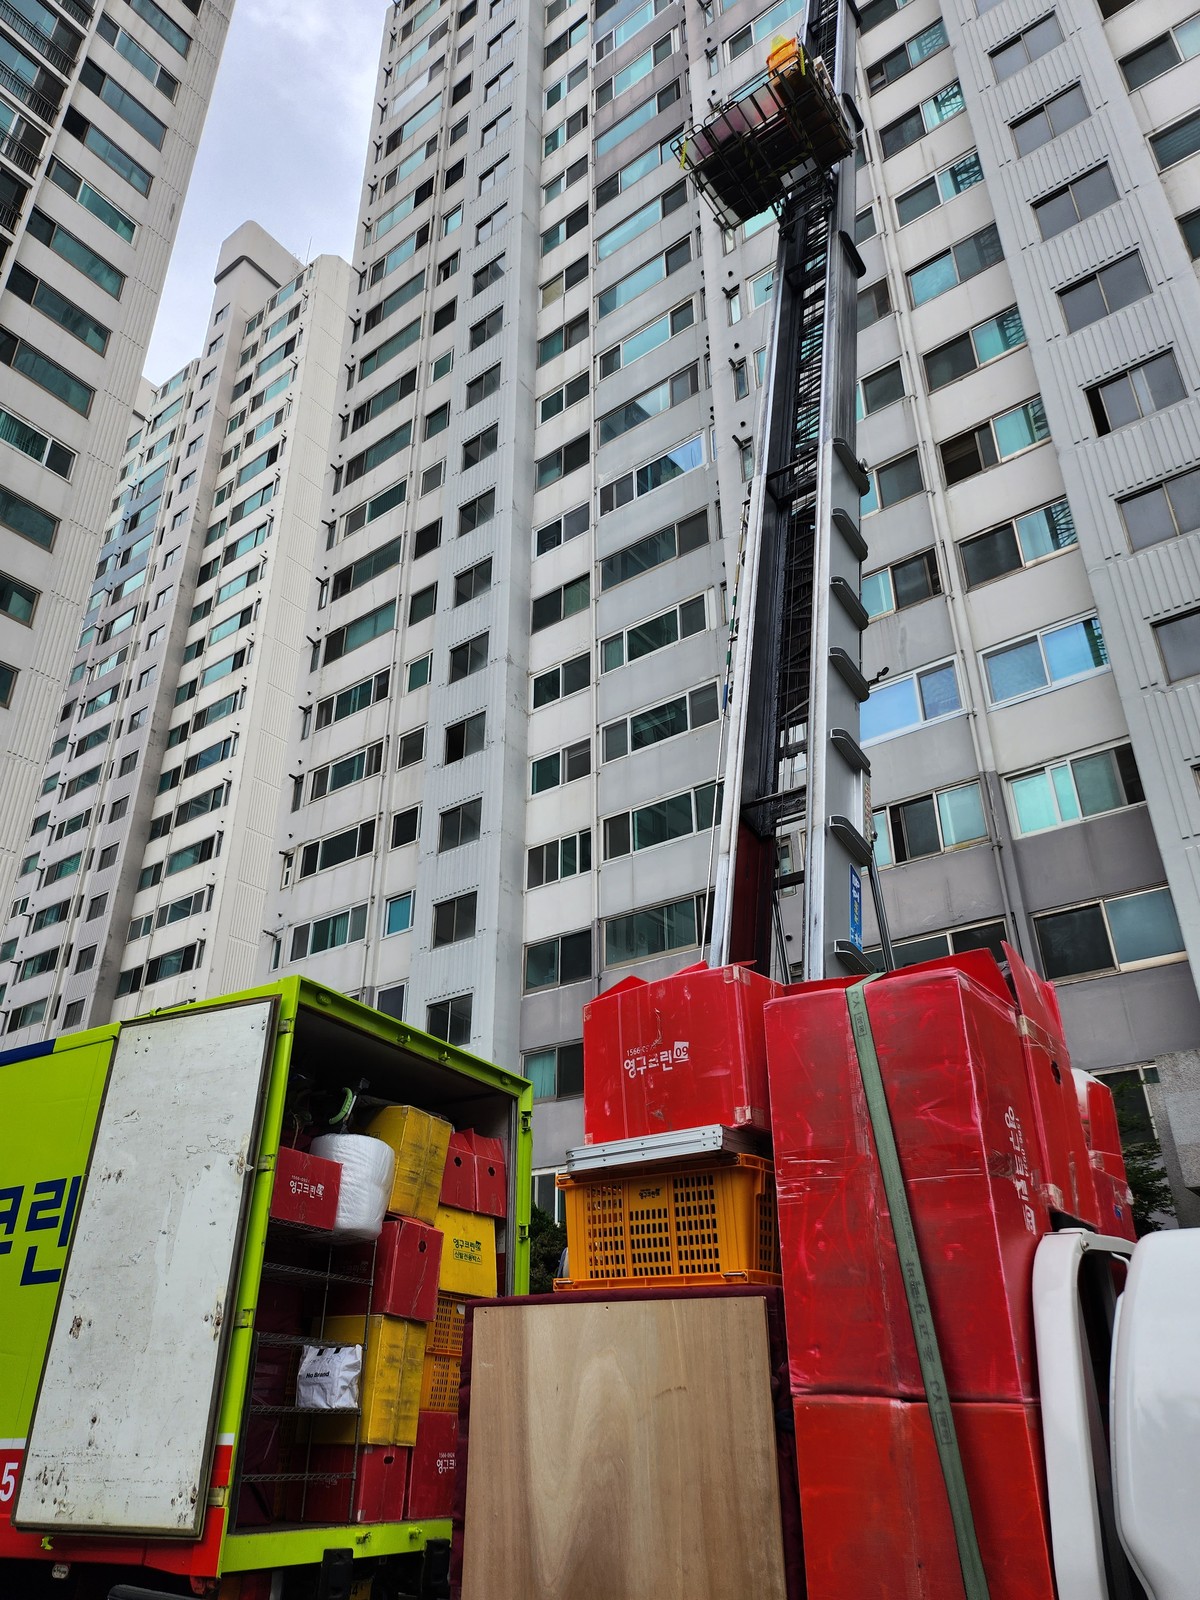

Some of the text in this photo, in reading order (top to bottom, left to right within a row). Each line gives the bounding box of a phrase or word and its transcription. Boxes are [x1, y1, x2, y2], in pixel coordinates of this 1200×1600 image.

[290, 1180, 316, 1199] 영구크린
[313, 1370, 331, 1378] Brand
[436, 1459, 457, 1474] 영구크
